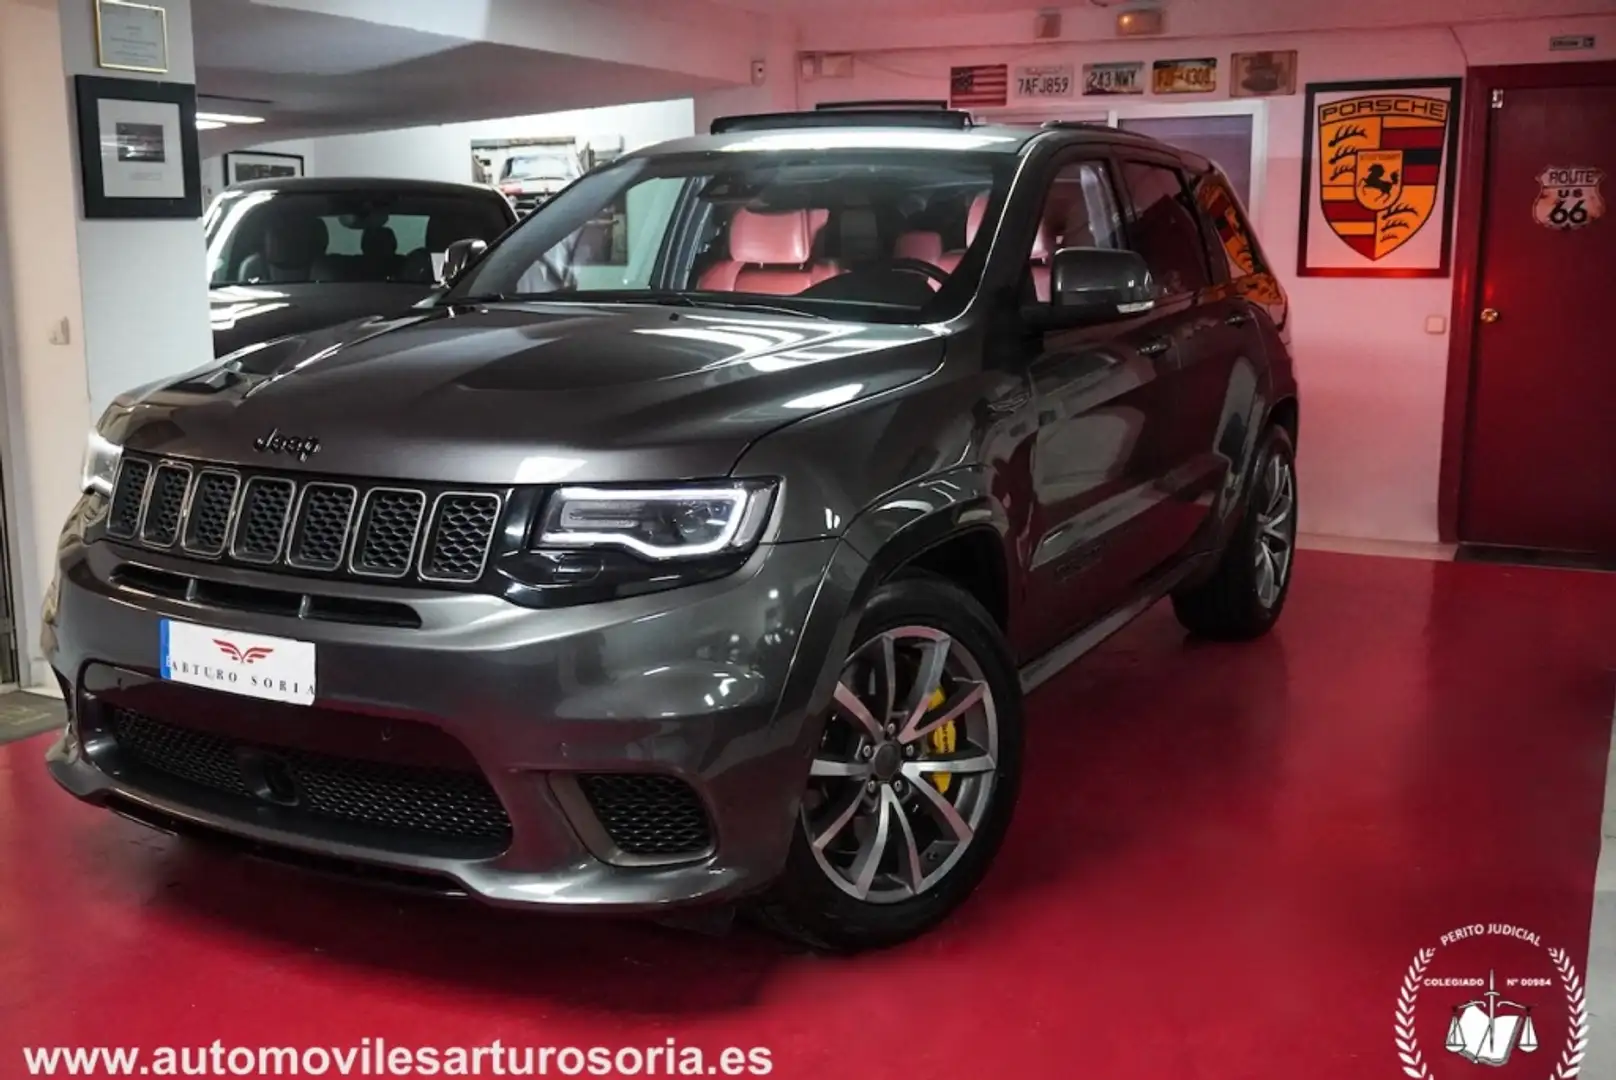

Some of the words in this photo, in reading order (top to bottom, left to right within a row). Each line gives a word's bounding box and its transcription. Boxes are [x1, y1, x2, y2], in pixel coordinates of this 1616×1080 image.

[1322, 99, 1444, 120] PORSCHE
[1549, 170, 1596, 185] ROUTE
[1550, 199, 1588, 224] 66
[253, 428, 321, 462] Jeep
[172, 660, 238, 683] ARTURO
[250, 676, 316, 695] SORIA
